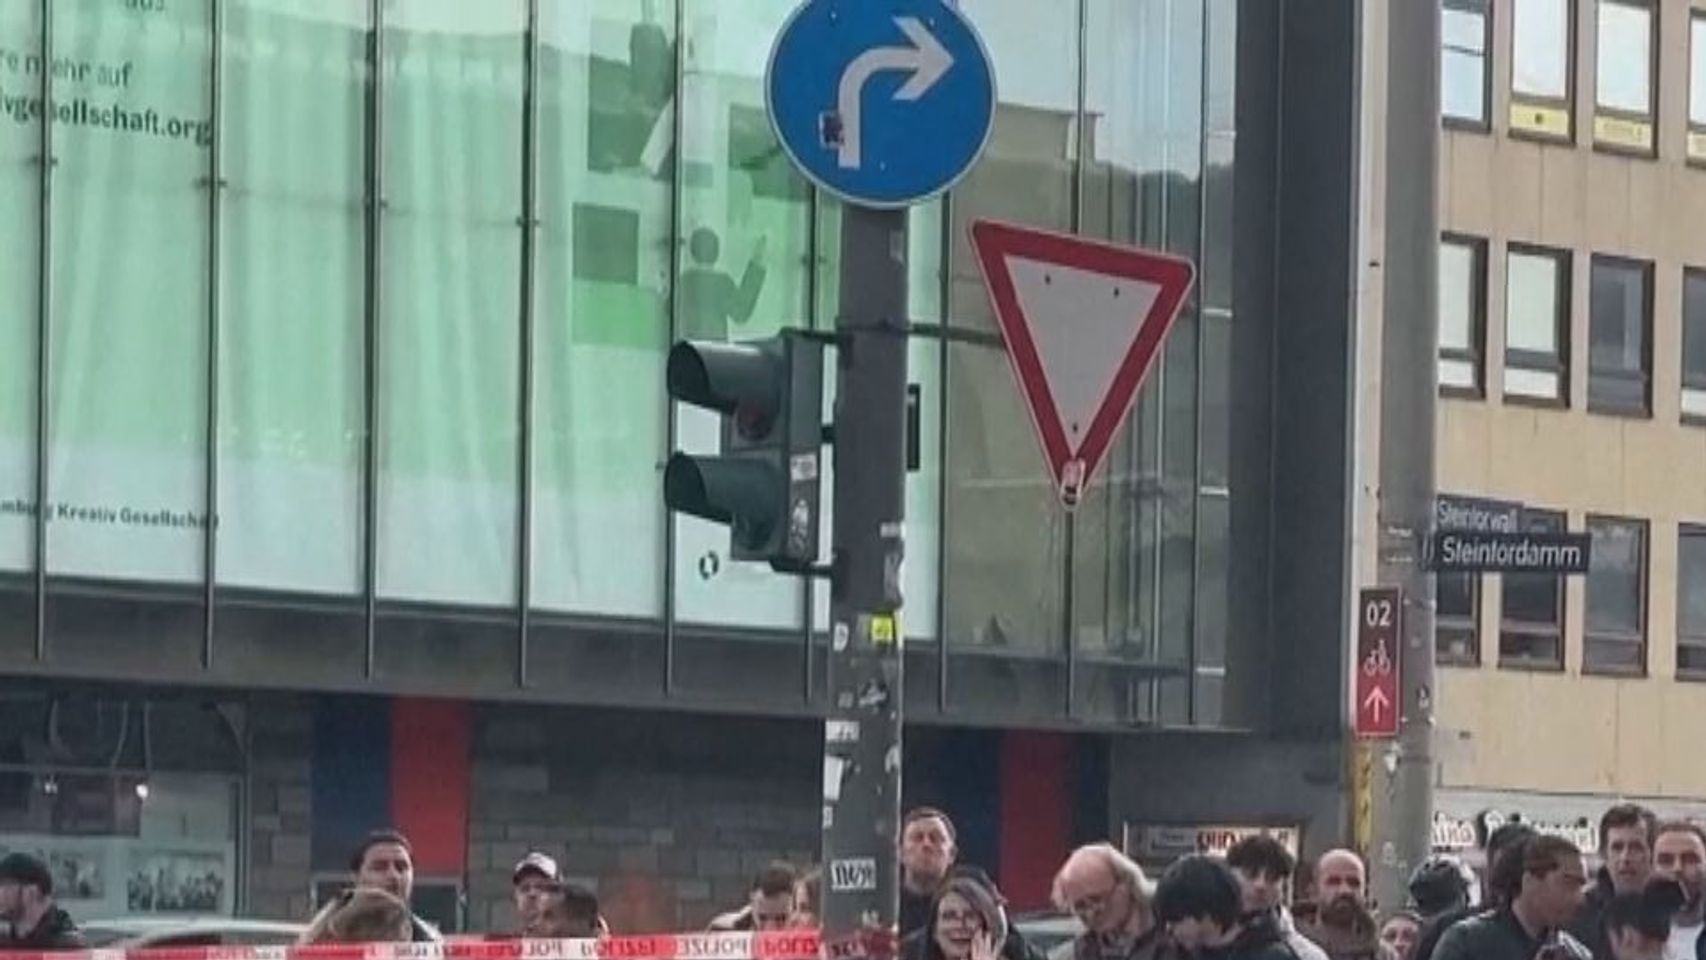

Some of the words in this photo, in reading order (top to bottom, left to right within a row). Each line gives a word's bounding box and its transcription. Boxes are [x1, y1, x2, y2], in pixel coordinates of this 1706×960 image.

[57, 504, 117, 524] Kreativ
[1442, 536, 1581, 568] Steintordamm
[1365, 600, 1392, 628] 02
